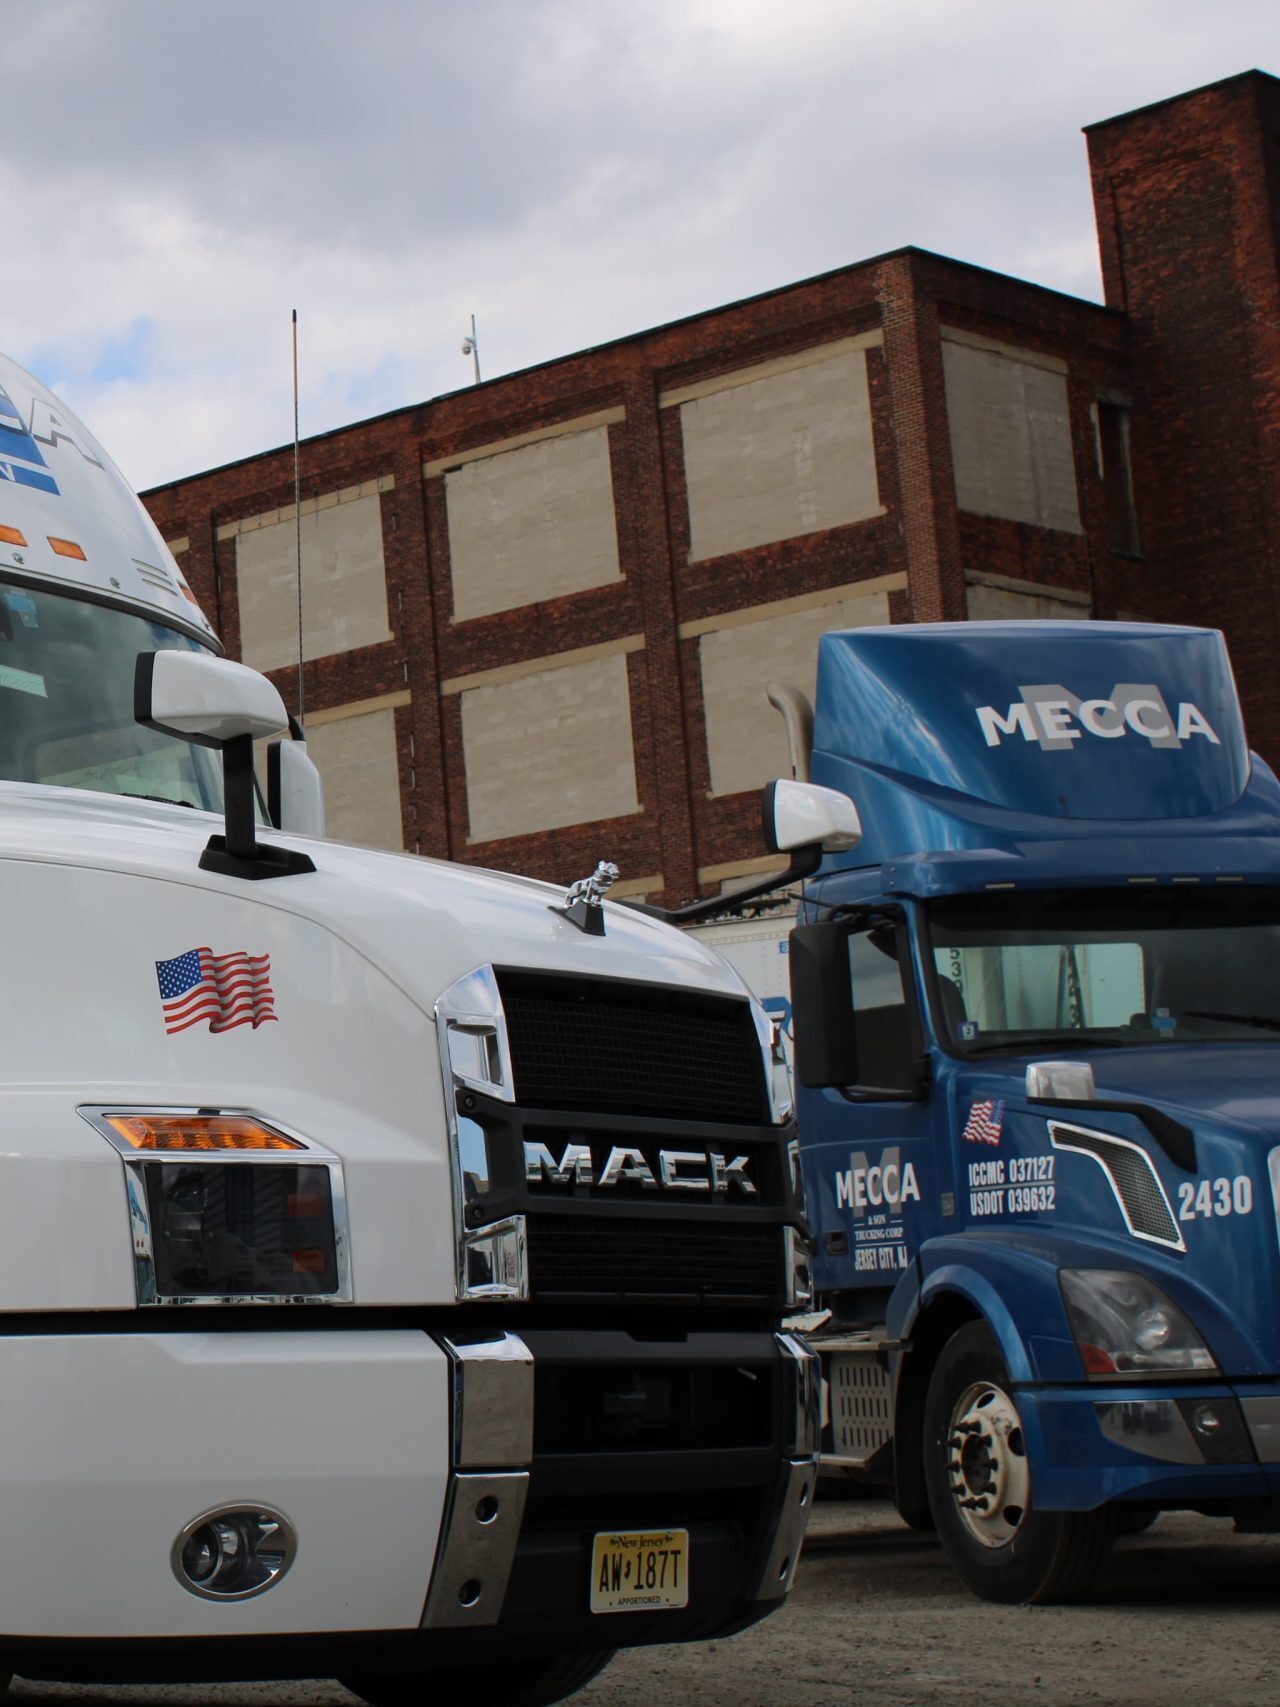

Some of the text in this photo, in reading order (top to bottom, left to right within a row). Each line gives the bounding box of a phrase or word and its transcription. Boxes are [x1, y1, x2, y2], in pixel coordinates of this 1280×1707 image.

[975, 699, 1221, 747] MECCA
[522, 1140, 758, 1193] MACK
[968, 1155, 1055, 1187] ICCMC 037127
[835, 1162, 921, 1209] MECCA
[969, 1185, 1056, 1216] USDOT 039632
[1178, 1175, 1252, 1221] 2430
[854, 1228, 885, 1241] TRUCKING
[854, 1248, 878, 1271] JERSEY
[617, 1535, 665, 1551] New Jersey
[617, 1595, 661, 1606] APPORTIONED
